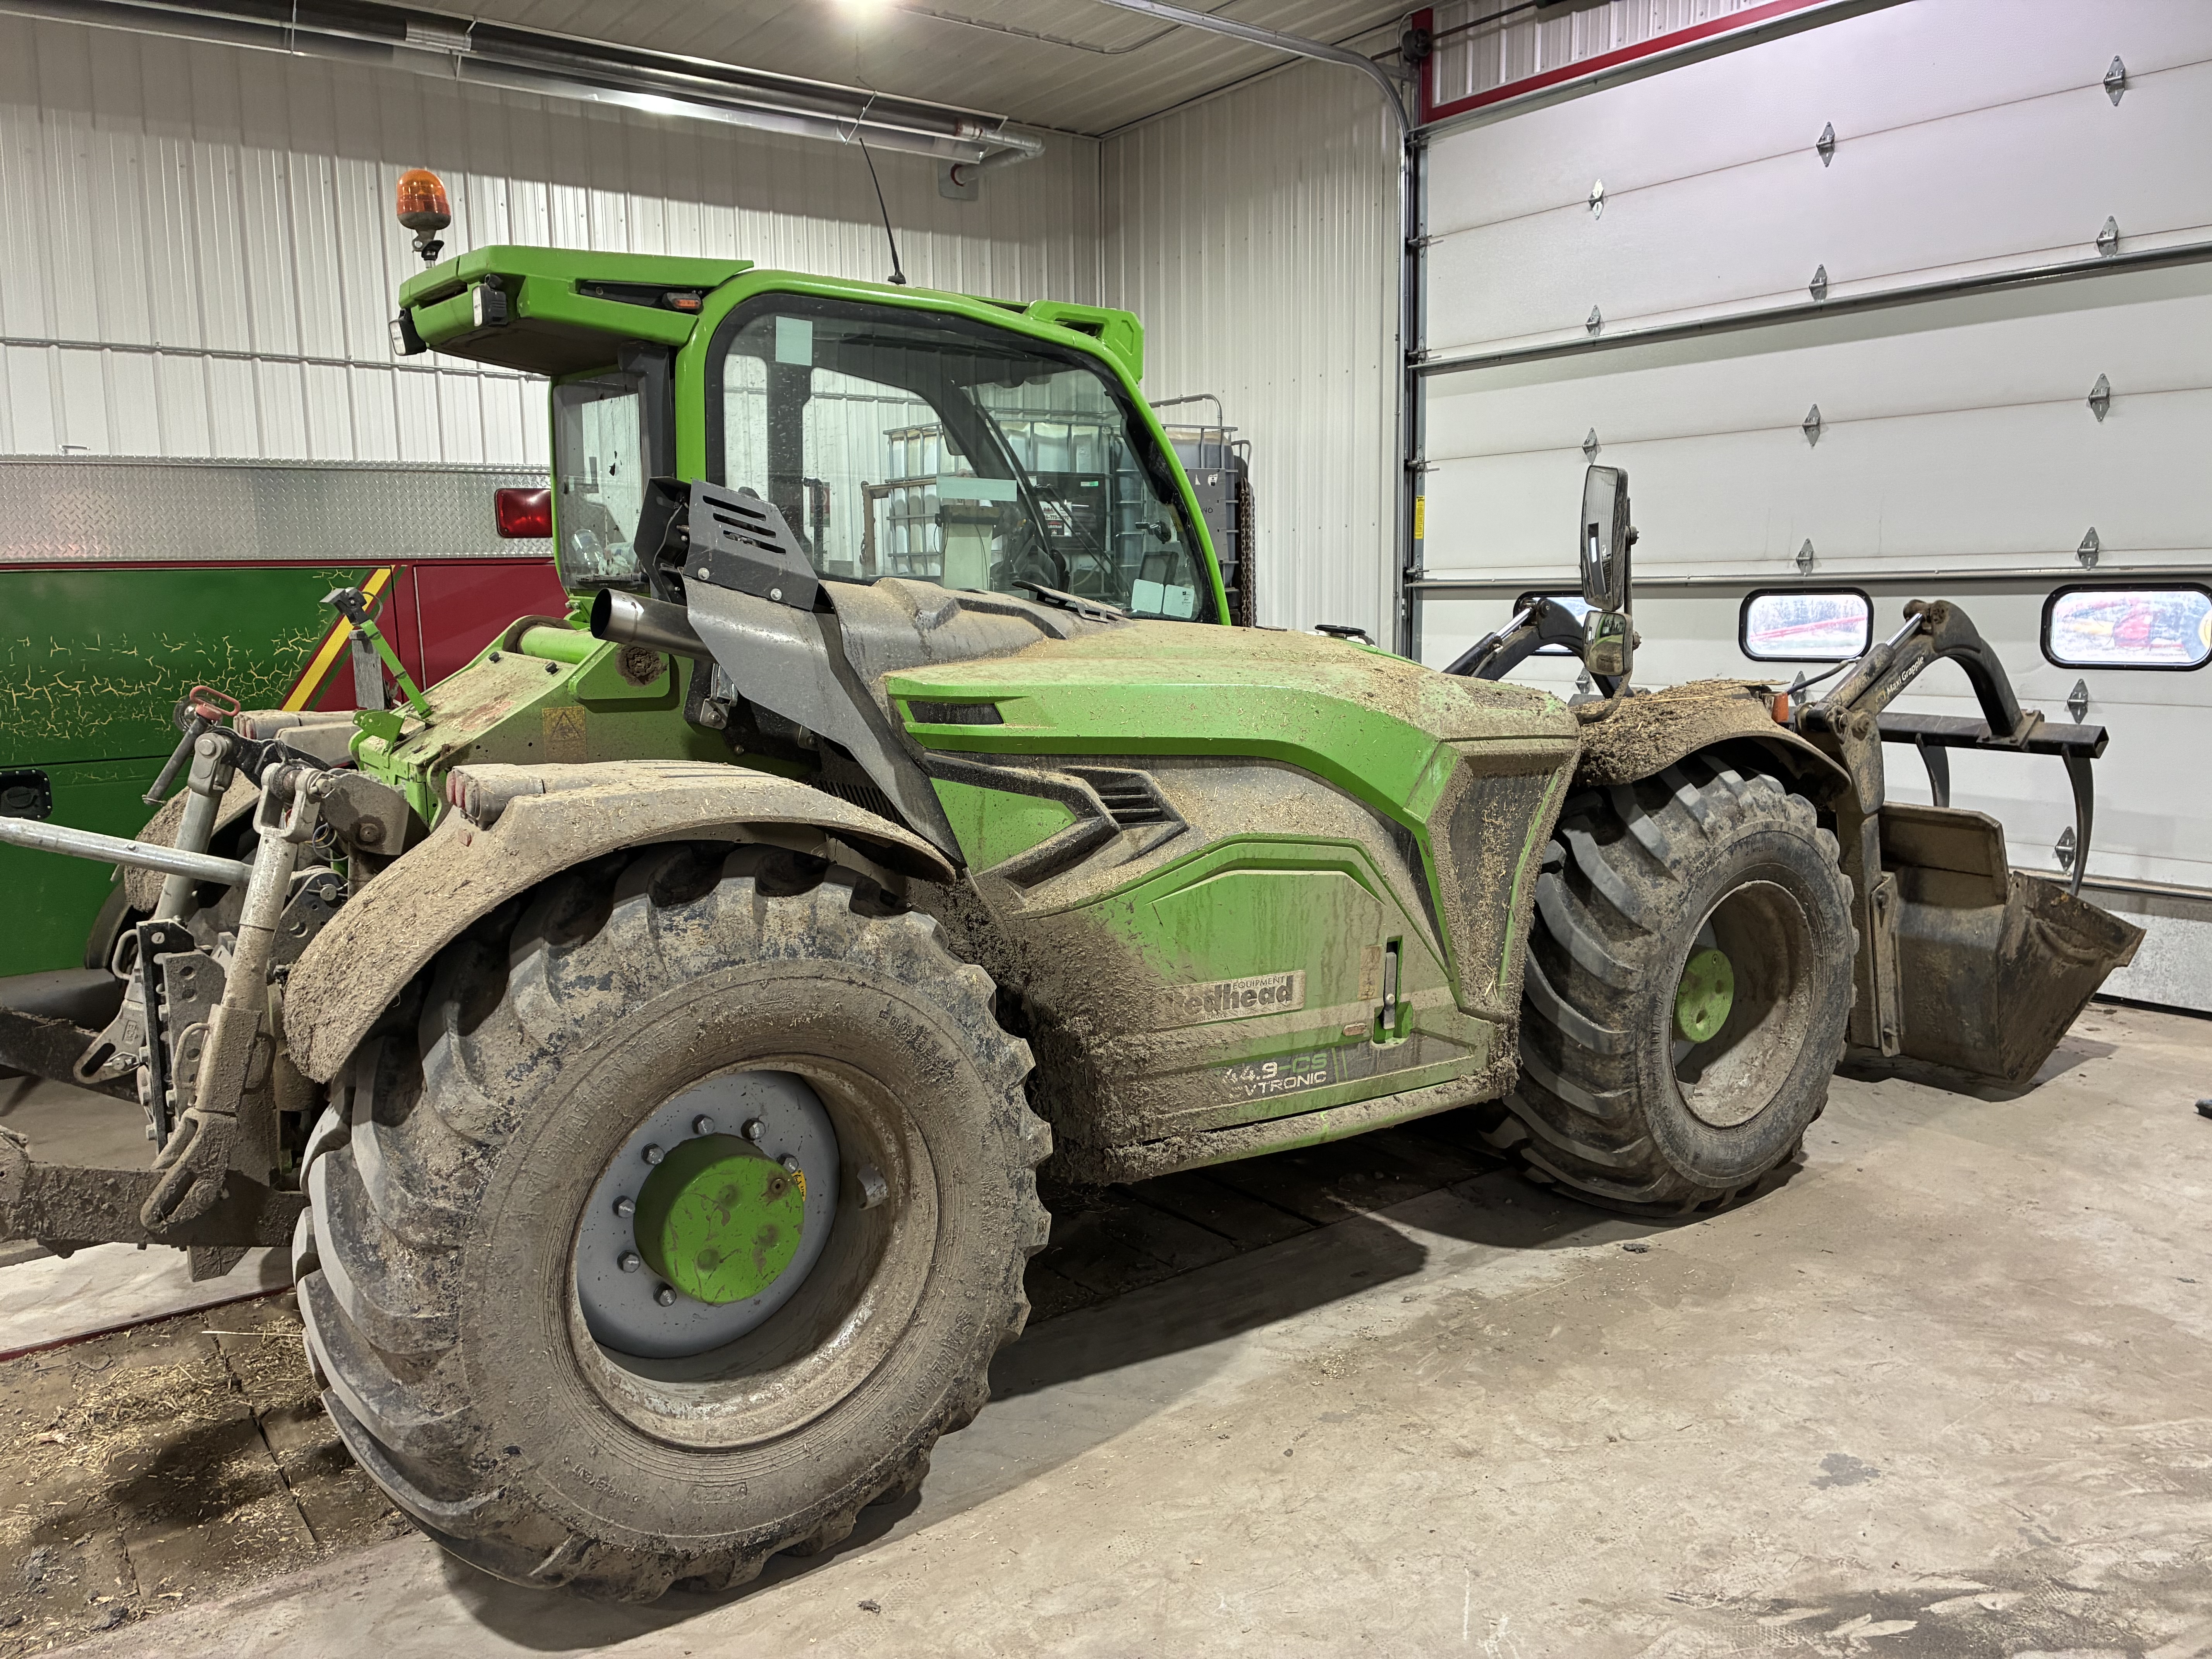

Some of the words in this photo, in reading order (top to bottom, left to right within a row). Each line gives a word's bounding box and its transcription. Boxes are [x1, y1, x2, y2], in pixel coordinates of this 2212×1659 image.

[1887, 675, 1902, 695] Maxi
[1902, 656, 1924, 681] Grapple
[1233, 975, 1285, 989] EQUIPMENT
